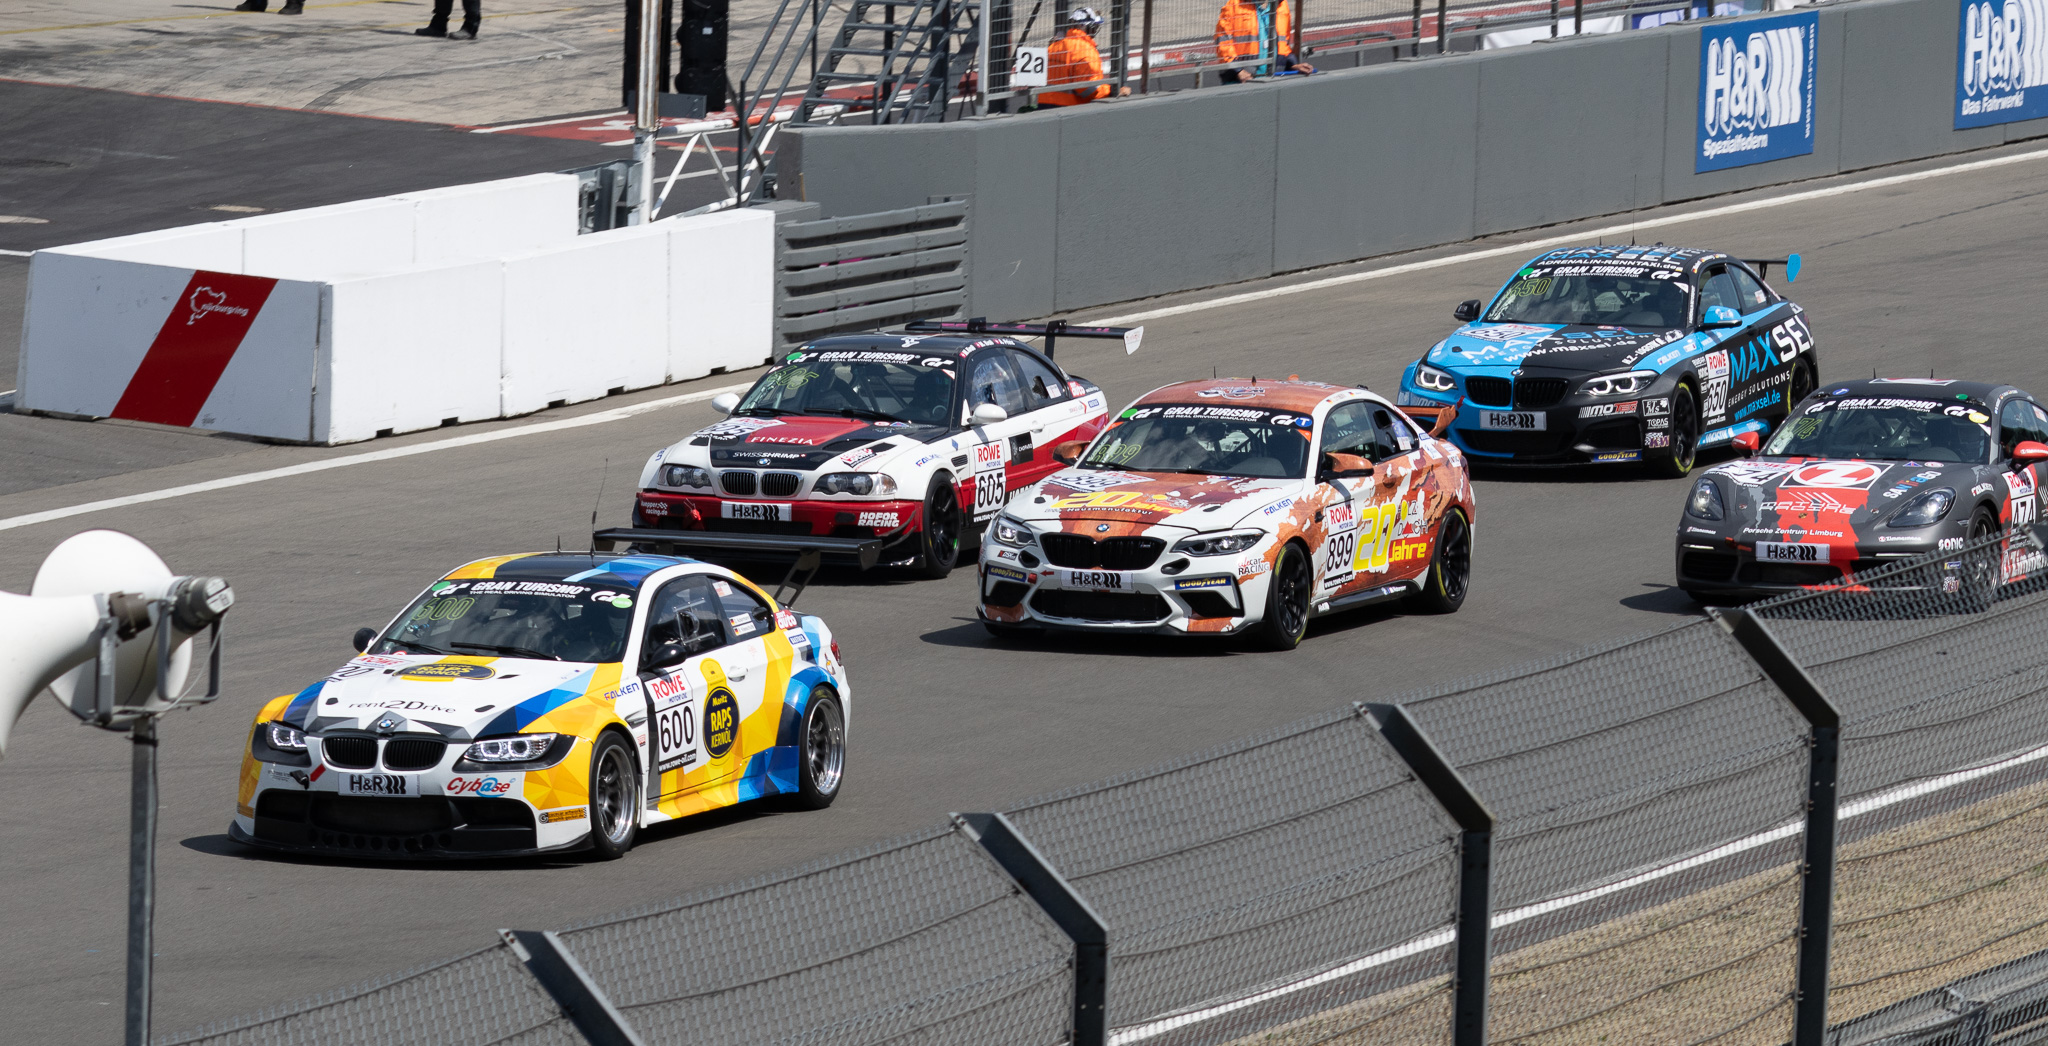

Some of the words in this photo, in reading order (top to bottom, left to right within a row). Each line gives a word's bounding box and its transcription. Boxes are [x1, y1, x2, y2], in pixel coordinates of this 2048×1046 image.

[1020, 51, 1044, 74] 2a
[1705, 32, 1772, 137] H&R
[1961, 98, 1981, 115] Das
[1703, 133, 1768, 159] Spezialfedern
[1554, 266, 1592, 274] GRAN
[1503, 340, 1637, 363] www.maxsel.de
[1729, 315, 1815, 389] MAXSEL
[1708, 353, 1726, 370] ROWE
[1708, 380, 1727, 412] 650
[1728, 389, 1748, 407] ENERGY
[1748, 370, 1790, 395] SOLUTIONS
[1164, 407, 1204, 415] GRAN
[1734, 389, 1781, 421] www.maxsel.de
[1838, 399, 1879, 407] GRAN
[1489, 412, 1517, 426] H&R
[750, 436, 813, 445] FINEZIA
[732, 451, 800, 459] SWISSSHRIMP
[977, 444, 1001, 462] ROWE
[1598, 450, 1638, 460] GOODYEAR
[977, 471, 1004, 508] 605
[1051, 491, 1143, 509] 20
[1263, 498, 1293, 516] FALKEN
[731, 504, 762, 518] H&R
[859, 512, 898, 520] HOFOR
[1329, 504, 1353, 525] ROWE
[857, 519, 900, 527] RACING
[1743, 527, 1774, 535] Porsche
[1809, 529, 1843, 537] Limburg
[1353, 502, 1396, 571] 20
[1326, 532, 1354, 573] 899
[1389, 539, 1427, 562] Jahre
[1766, 544, 1797, 559] H&R
[990, 567, 1024, 580] GOODYEAR
[1238, 561, 1270, 576] RACING
[470, 582, 513, 591] GRAN
[1071, 571, 1102, 586] H&R
[1179, 577, 1227, 588] GOODYEAR
[532, 591, 575, 599] SIMULATOR
[412, 598, 475, 621] 600
[603, 682, 640, 702] FALKEN
[651, 675, 686, 699] ROWE
[348, 700, 457, 714] rent2Drive
[711, 706, 732, 732] RAPS
[660, 705, 694, 753] 600
[349, 774, 386, 794] H&R
